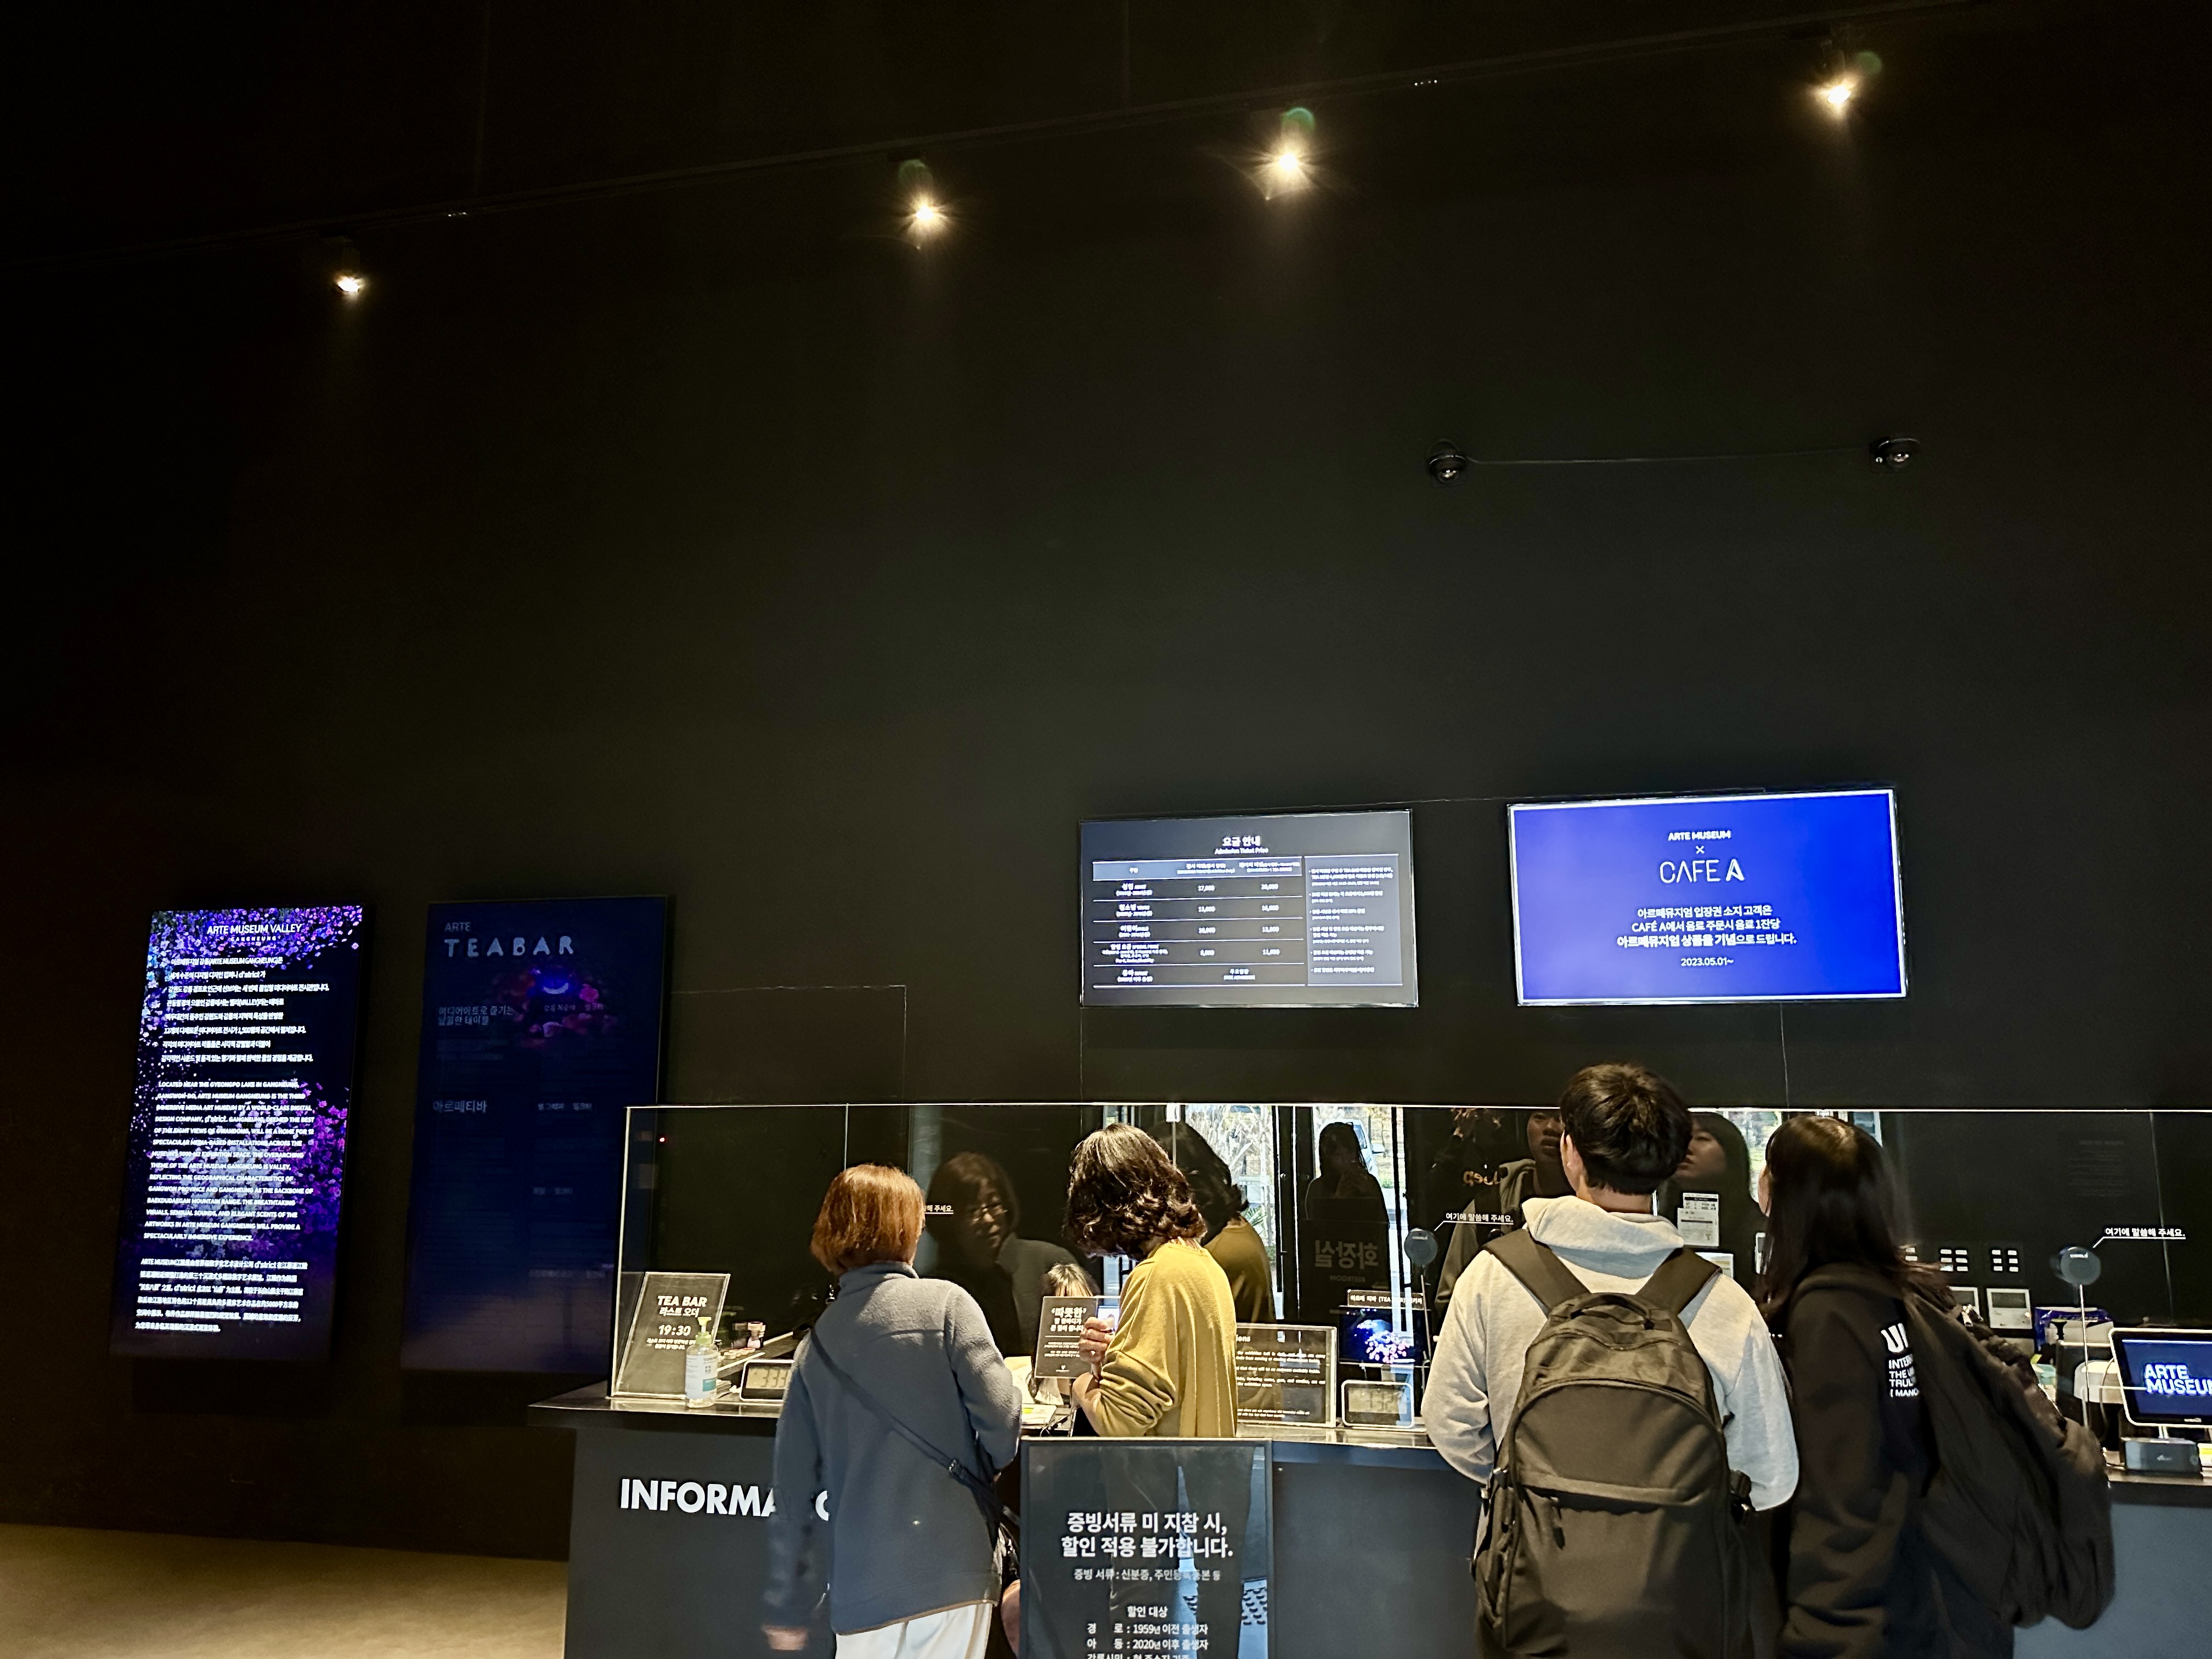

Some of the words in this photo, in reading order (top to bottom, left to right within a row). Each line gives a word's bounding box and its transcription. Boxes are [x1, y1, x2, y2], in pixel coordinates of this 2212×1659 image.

[1222, 836, 1241, 847] 요금
[1242, 835, 1261, 847] 안내
[1668, 832, 1691, 842] ARTE
[1691, 830, 1731, 840] MUSEUM
[1660, 859, 1721, 883] CAFE
[1725, 858, 1745, 882] A
[1637, 907, 1693, 919] 아르떼뮤지엄
[1694, 906, 1722, 918] 입장권
[1723, 905, 1742, 917] 소지
[1743, 904, 1773, 916] 고객은
[207, 925, 229, 934] ARTE
[230, 924, 269, 934] MUSEUM
[270, 923, 303, 933] VALLEY
[444, 922, 472, 932] ARTE
[1632, 919, 1657, 932] CAFÉ
[1658, 920, 1685, 932] A에서
[1685, 919, 1705, 931] 음료
[1706, 919, 1734, 930] 주문시
[1735, 918, 1755, 930] 음료
[1755, 918, 1780, 930] 1잔당
[444, 935, 574, 958] TEABAR
[1617, 935, 1680, 949] 아르떼뮤지엄
[1681, 934, 1714, 947] 상품을
[1714, 933, 1755, 946] 기념으로
[1756, 932, 1798, 945] 드립니다.
[1680, 957, 1734, 967] 2023.05.01~
[1446, 1212, 1467, 1221] 여기에
[1468, 1213, 1489, 1222] 말씀해
[1491, 1214, 1514, 1223] 주세요.
[2105, 1227, 2130, 1237] 여기에
[2131, 1228, 2157, 1237] 말씀해
[2158, 1228, 2186, 1237] 주세요.
[658, 1295, 680, 1306] TEA
[681, 1296, 708, 1307] BAR
[659, 1307, 682, 1317] 라스트
[682, 1307, 700, 1318] 오더
[658, 1324, 691, 1336] 19:30
[1889, 1369, 1908, 1379] THE
[2145, 1363, 2190, 1379] ARTE
[1068, 1511, 1137, 1533] 증빙서류
[1142, 1512, 1158, 1533] 미
[1164, 1512, 1199, 1533] 지참
[1203, 1512, 1227, 1536] 시,
[1062, 1536, 1096, 1558] 할인
[1101, 1536, 1137, 1558] 적용
[1141, 1536, 1233, 1559] 불가합니다.
[1073, 1568, 1093, 1581] 증빙
[1121, 1569, 1153, 1582] 신분증,
[1127, 1606, 1146, 1618] 할인
[1148, 1605, 1168, 1618] 대상
[1132, 1623, 1161, 1635] 1959년
[1162, 1623, 1180, 1635] 이전
[1182, 1623, 1209, 1635] 출생자
[1132, 1639, 1161, 1650] 2020년
[1162, 1639, 1180, 1650] 이후
[1182, 1639, 1209, 1651] 출생자
